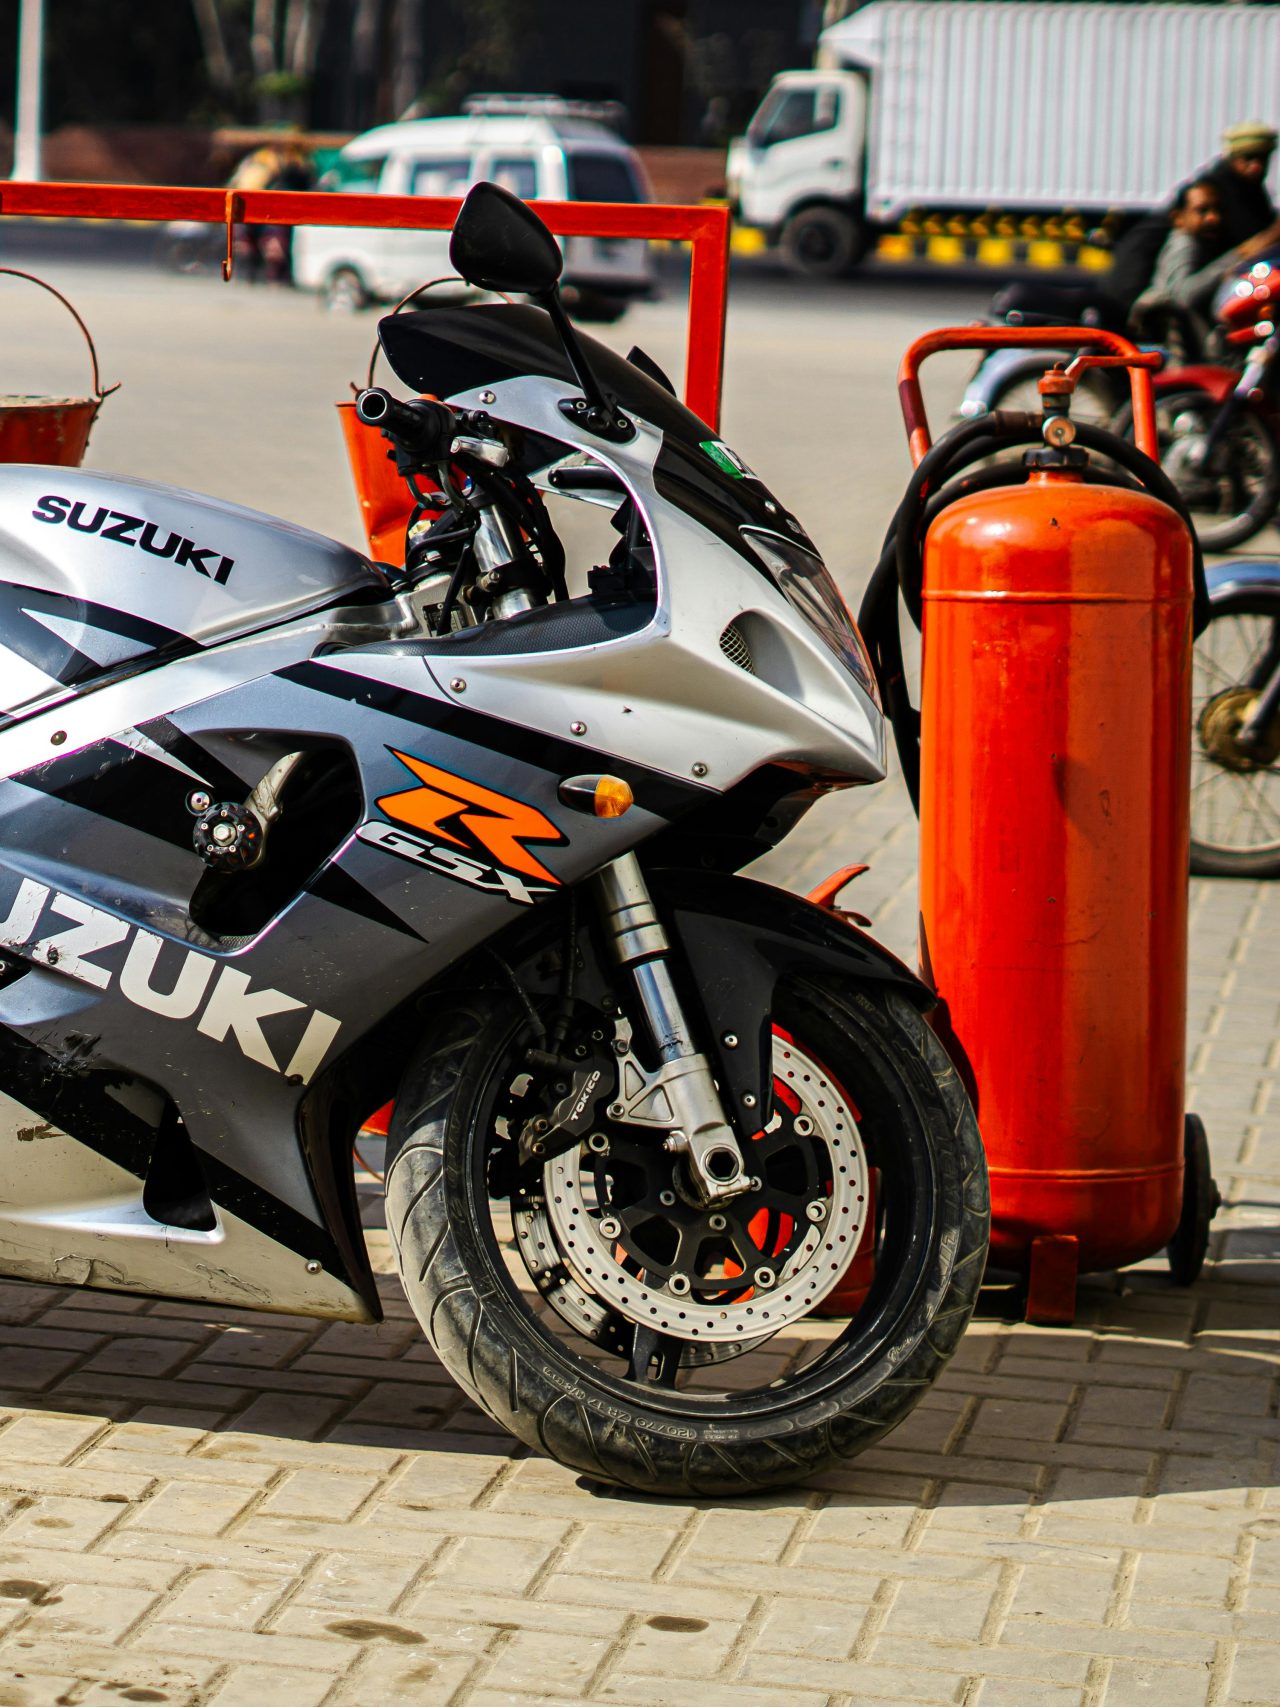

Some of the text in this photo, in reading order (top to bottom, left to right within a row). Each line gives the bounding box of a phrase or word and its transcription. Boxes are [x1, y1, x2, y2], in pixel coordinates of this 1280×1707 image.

[32, 495, 235, 586] SUZUKI
[355, 820, 558, 905] GSX
[571, 1070, 600, 1121] TOKICO
[636, 1416, 697, 1440] 120/70
